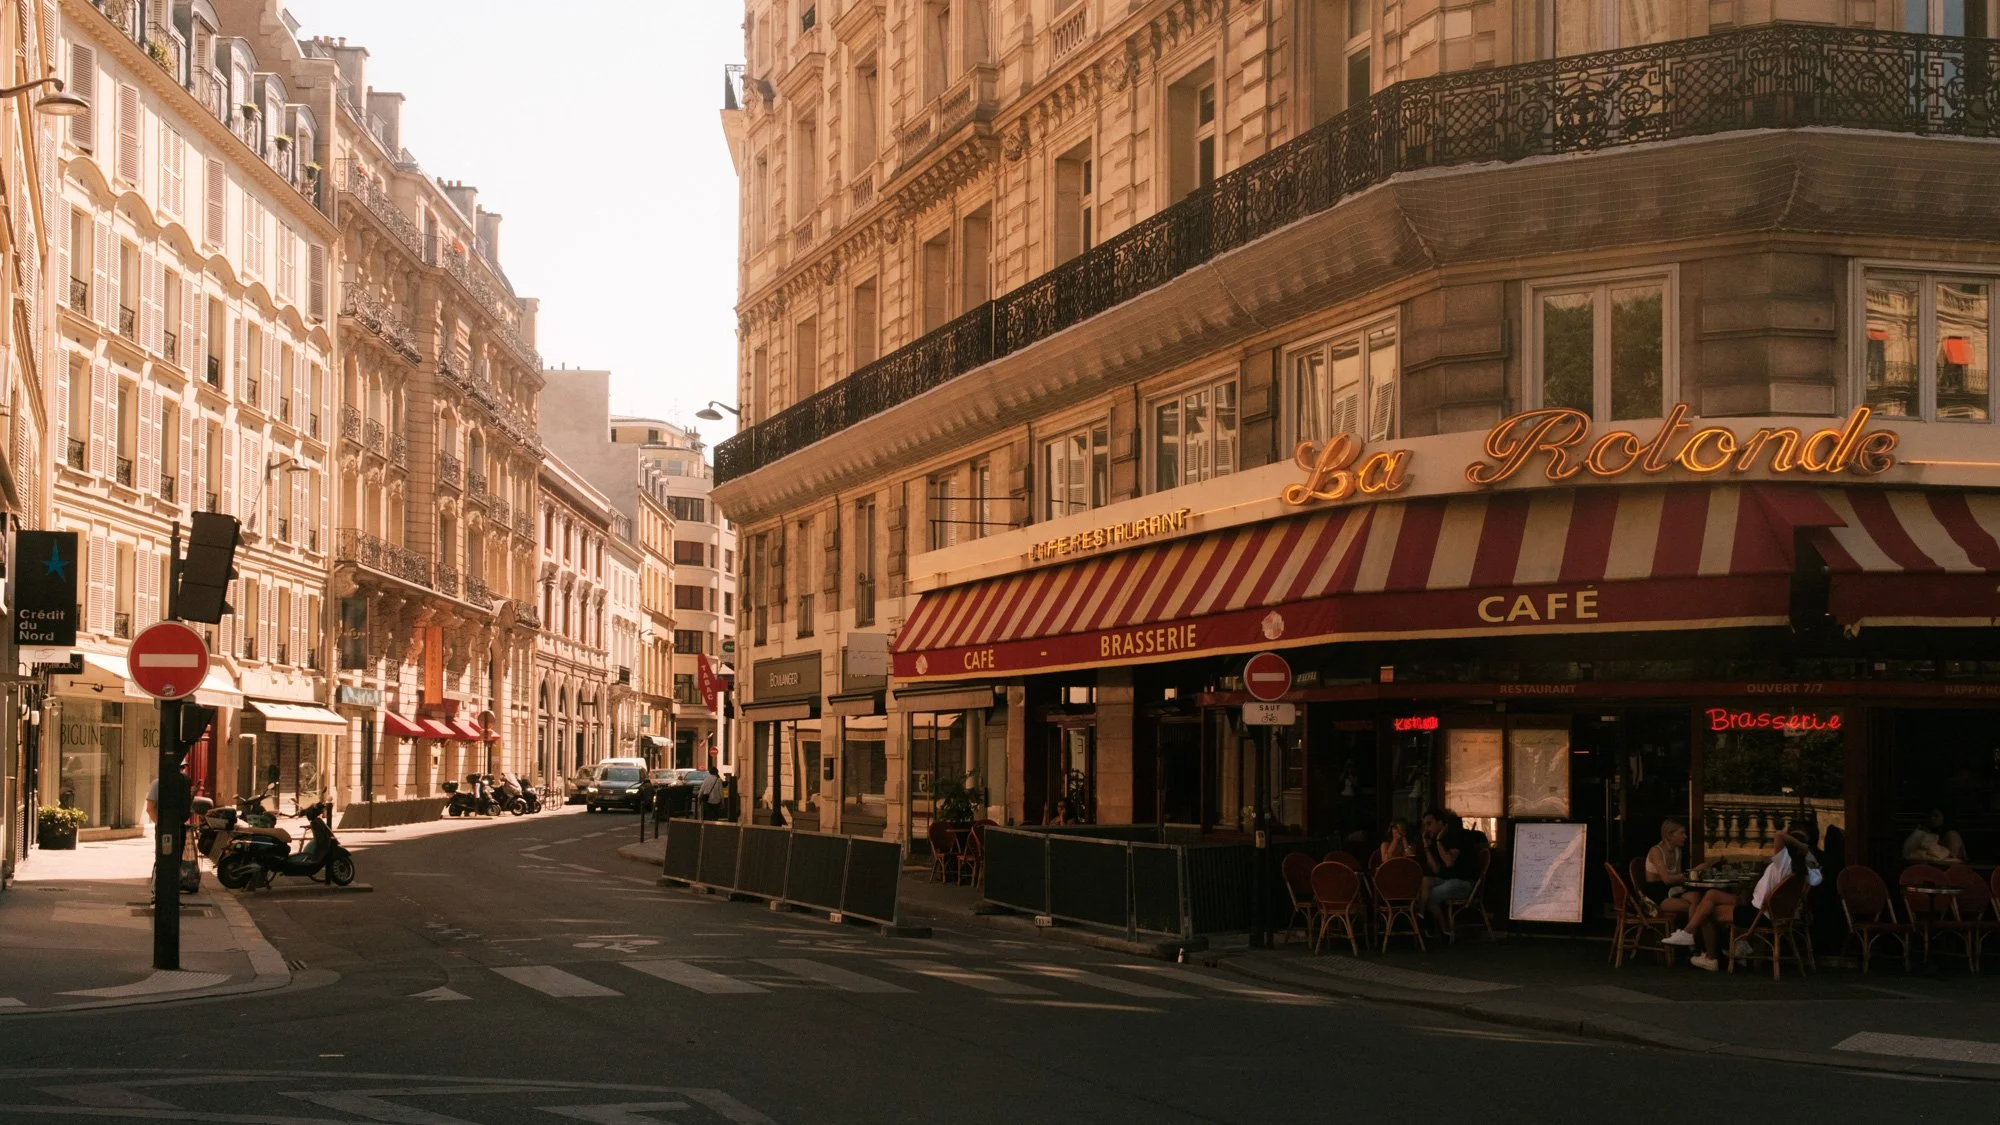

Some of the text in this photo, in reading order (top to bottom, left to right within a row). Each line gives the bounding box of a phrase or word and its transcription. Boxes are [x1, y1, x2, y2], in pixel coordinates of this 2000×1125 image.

[1281, 403, 1900, 505] La Rotonde
[1071, 508, 1190, 552] RESTAURANT
[19, 609, 65, 620] Crédit
[1477, 584, 1598, 623] CAFÉ
[19, 620, 37, 630] du
[19, 631, 54, 641] Nord
[964, 624, 1196, 670] CAFÉ BRASSERIE
[701, 664, 713, 700] TABAC
[1500, 684, 1576, 694] RESTAURANT
[1747, 683, 1824, 693] OUVERT 7/7
[1945, 684, 1982, 695] HAPPY
[1706, 708, 1841, 731] Brasserie
[60, 724, 105, 746] BIGUINE
